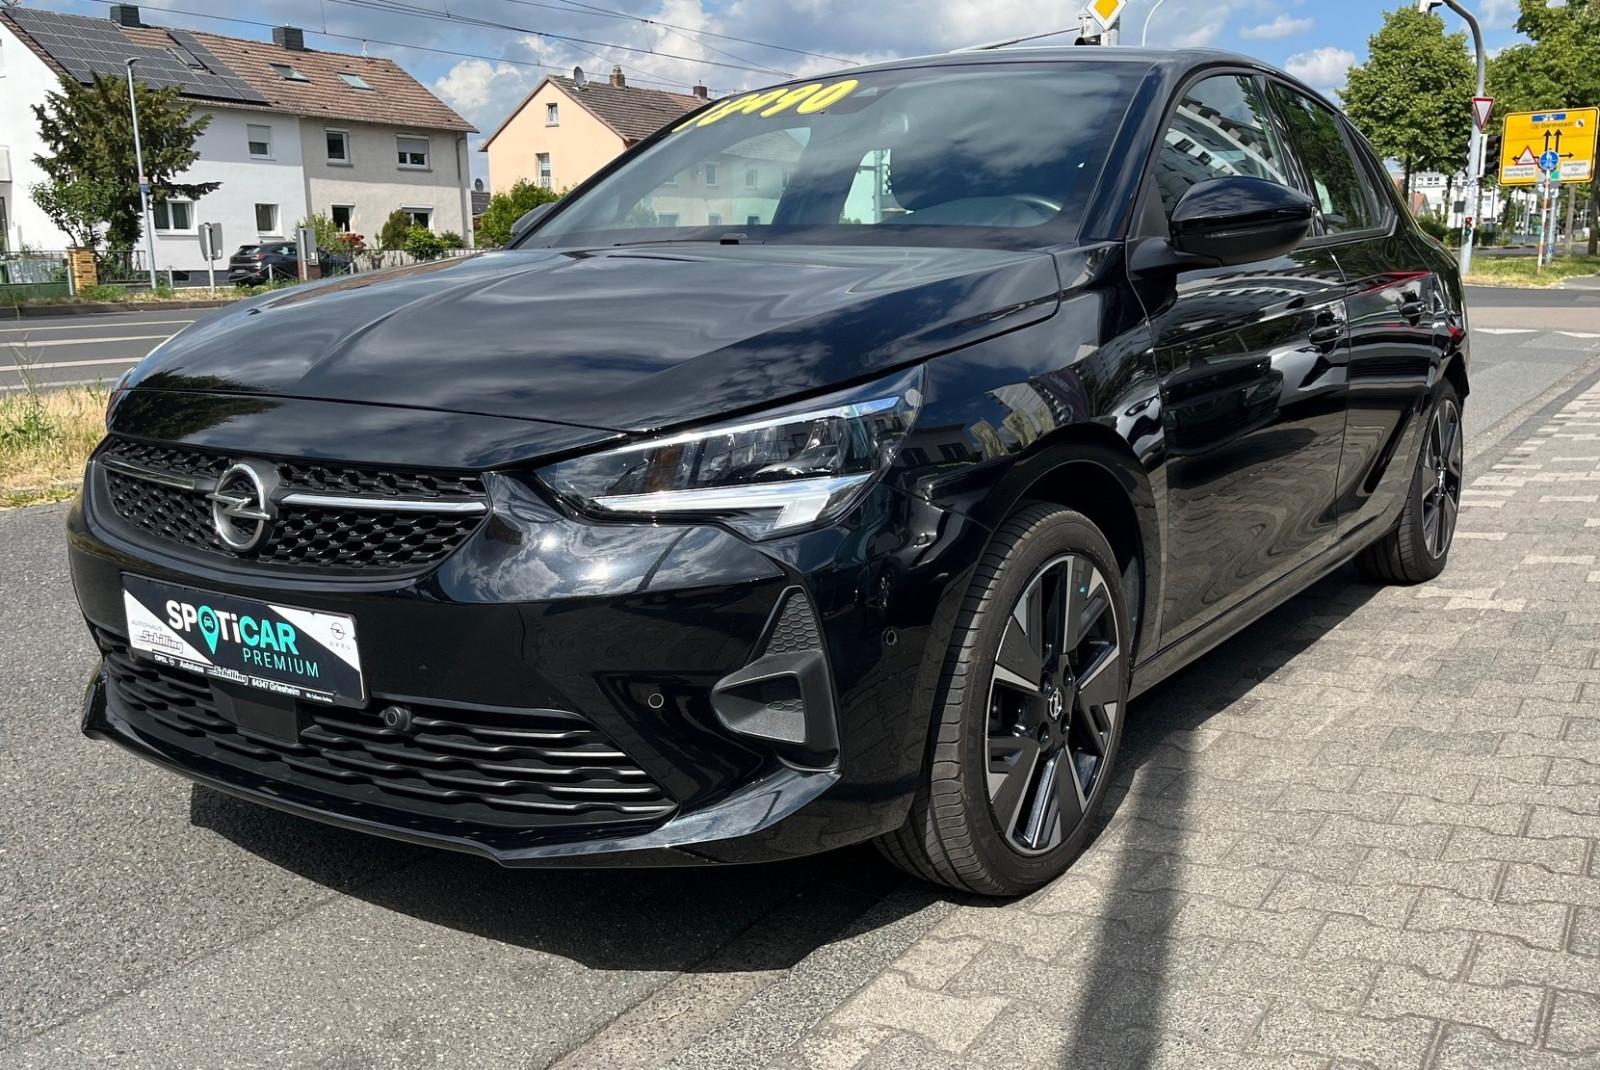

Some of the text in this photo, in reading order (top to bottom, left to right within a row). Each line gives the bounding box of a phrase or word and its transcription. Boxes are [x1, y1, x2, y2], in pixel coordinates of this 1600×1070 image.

[139, 630, 184, 654] Schilling
[242, 647, 320, 679] PREMIUM
[210, 665, 249, 686] Schilling
